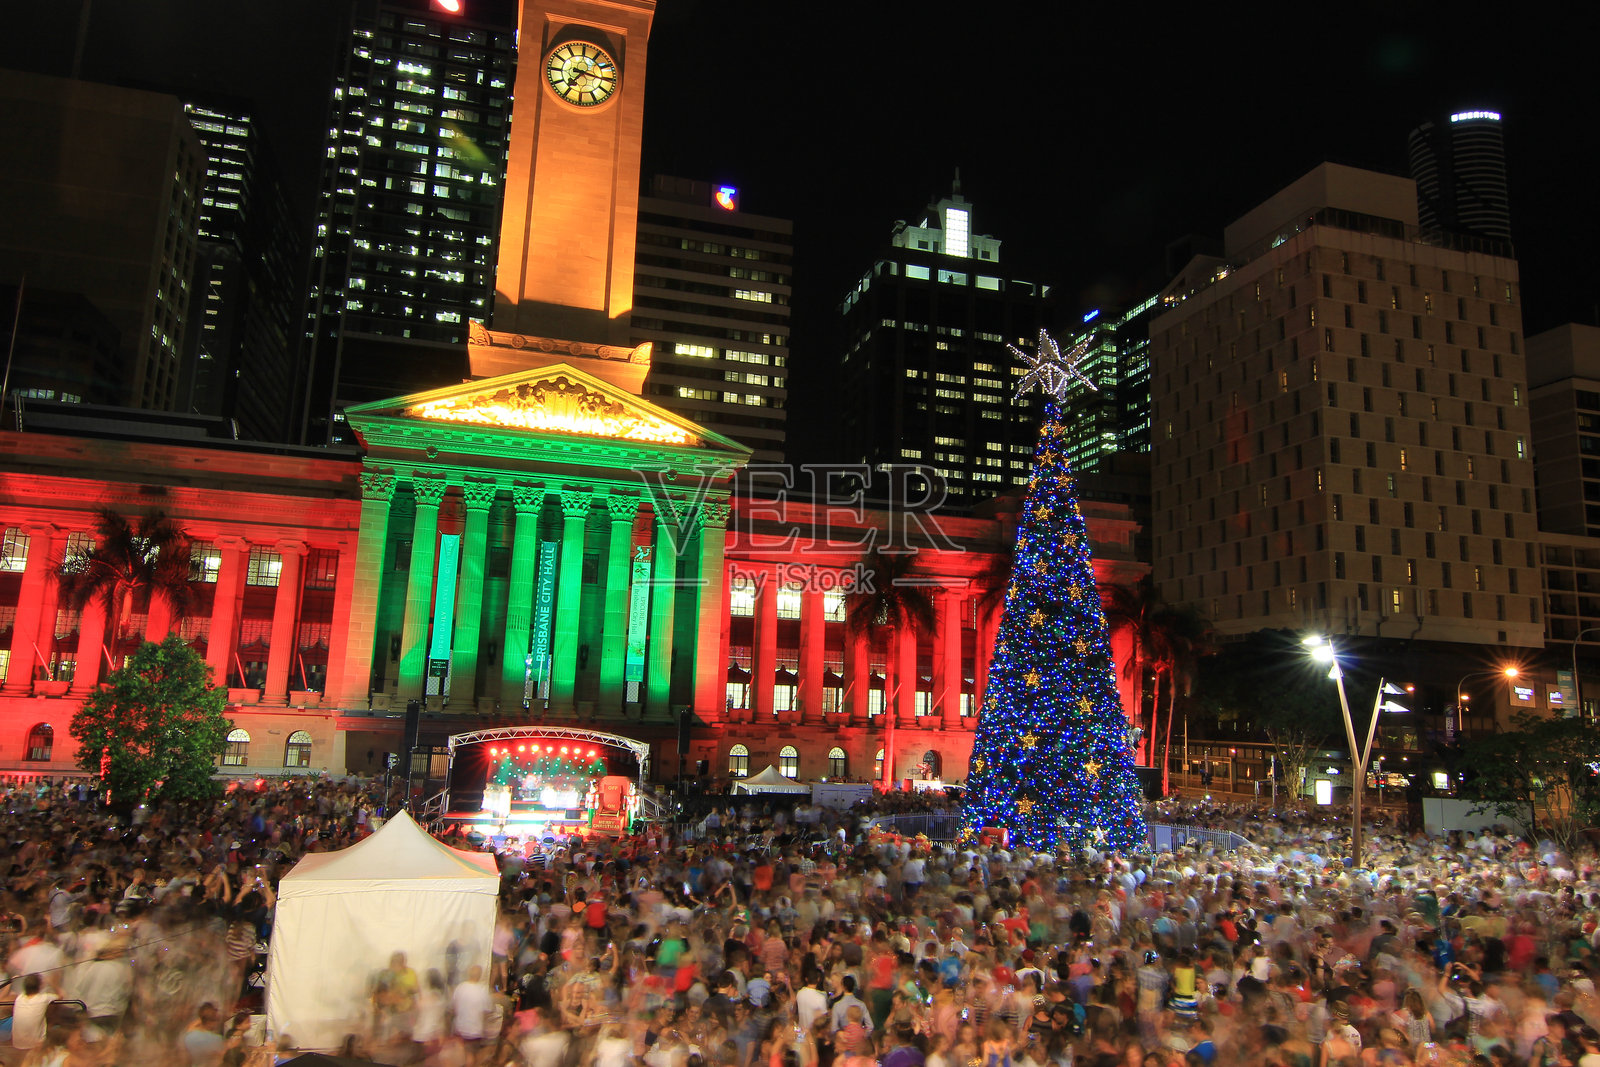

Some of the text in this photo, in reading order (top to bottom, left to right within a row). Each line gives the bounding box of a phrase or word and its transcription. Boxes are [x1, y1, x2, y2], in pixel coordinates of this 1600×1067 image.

[536, 547, 555, 662] BRISBANE CITY HALL
